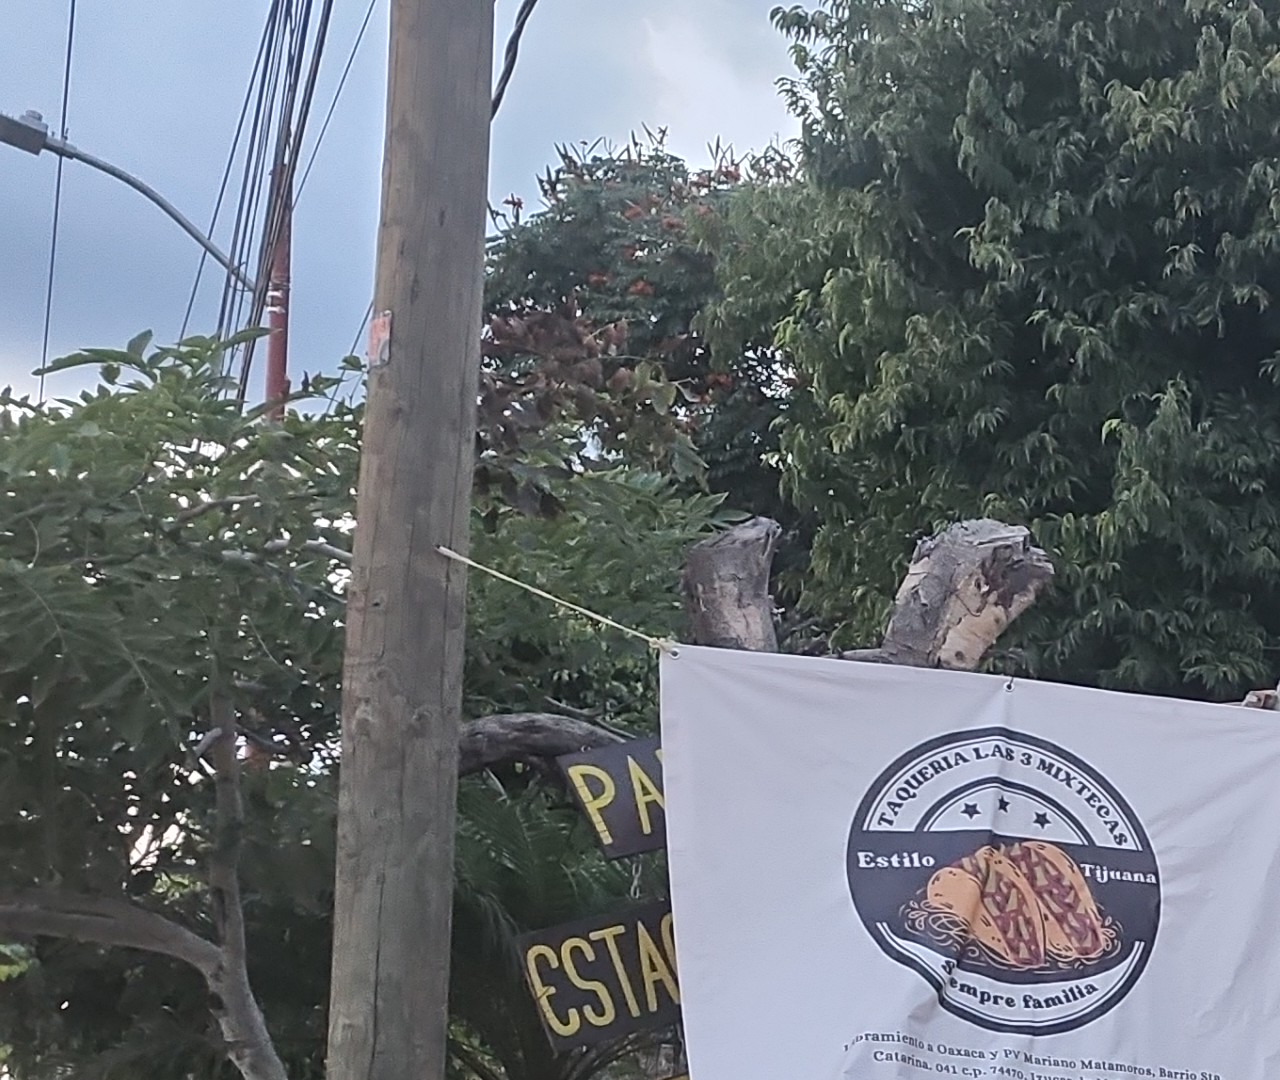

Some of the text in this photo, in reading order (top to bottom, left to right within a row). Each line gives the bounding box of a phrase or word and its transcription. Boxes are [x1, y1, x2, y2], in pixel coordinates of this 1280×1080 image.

[566, 747, 666, 846] PA
[876, 744, 1129, 847] TAQUERIA LAS 3 MIXTECAS
[857, 851, 936, 869] Estilo
[1080, 862, 1157, 885] Tijuana
[1022, 982, 1099, 1011] familia
[937, 1044, 986, 1059] Oaxaca
[988, 1050, 998, 1060] y
[1003, 1048, 1022, 1059] PV
[1023, 1052, 1076, 1069] Mariano
[1081, 1059, 1156, 1077] Matamoros,
[1159, 1067, 1197, 1080] Barrio
